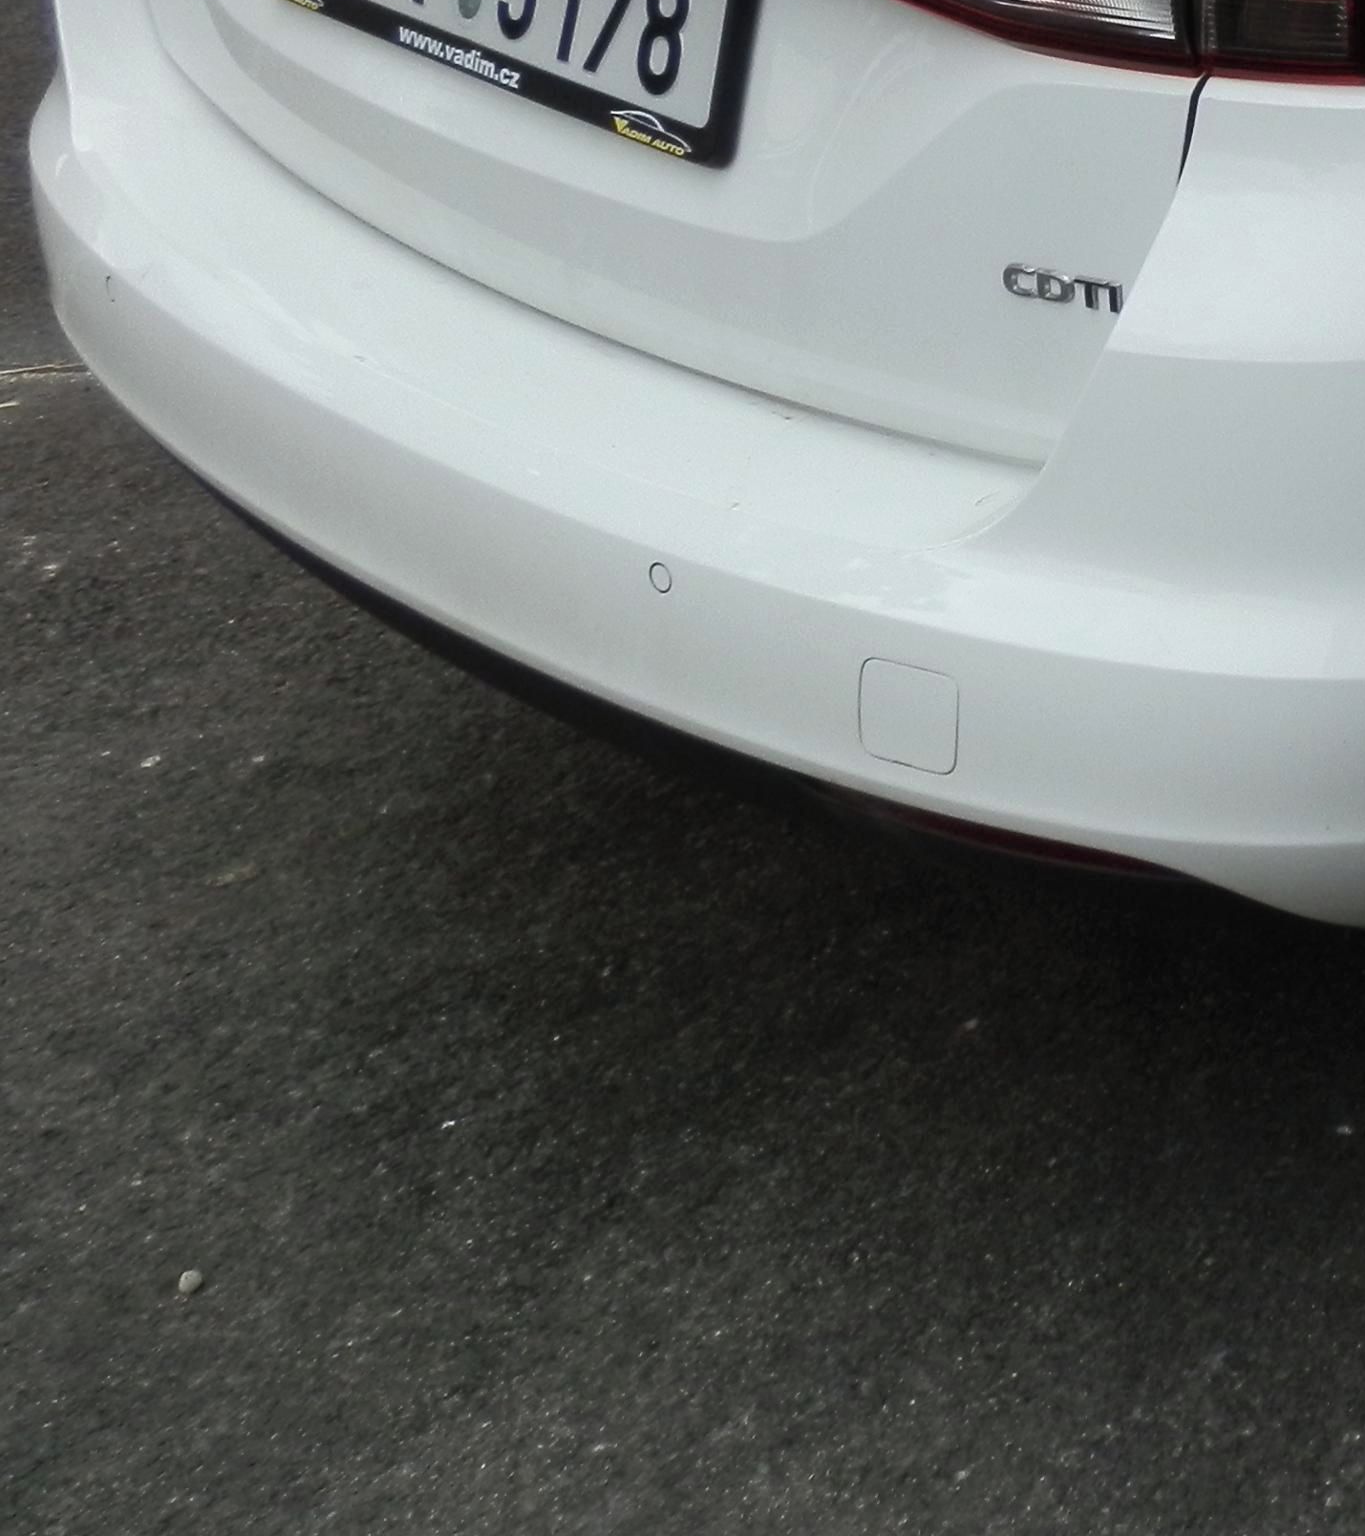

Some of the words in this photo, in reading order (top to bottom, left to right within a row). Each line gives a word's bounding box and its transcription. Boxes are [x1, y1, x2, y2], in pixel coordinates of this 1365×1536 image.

[399, 26, 521, 89] www.vadim.cz
[613, 116, 652, 144] VADIM
[651, 139, 685, 156] AUTO
[1002, 262, 1124, 314] CDTI
